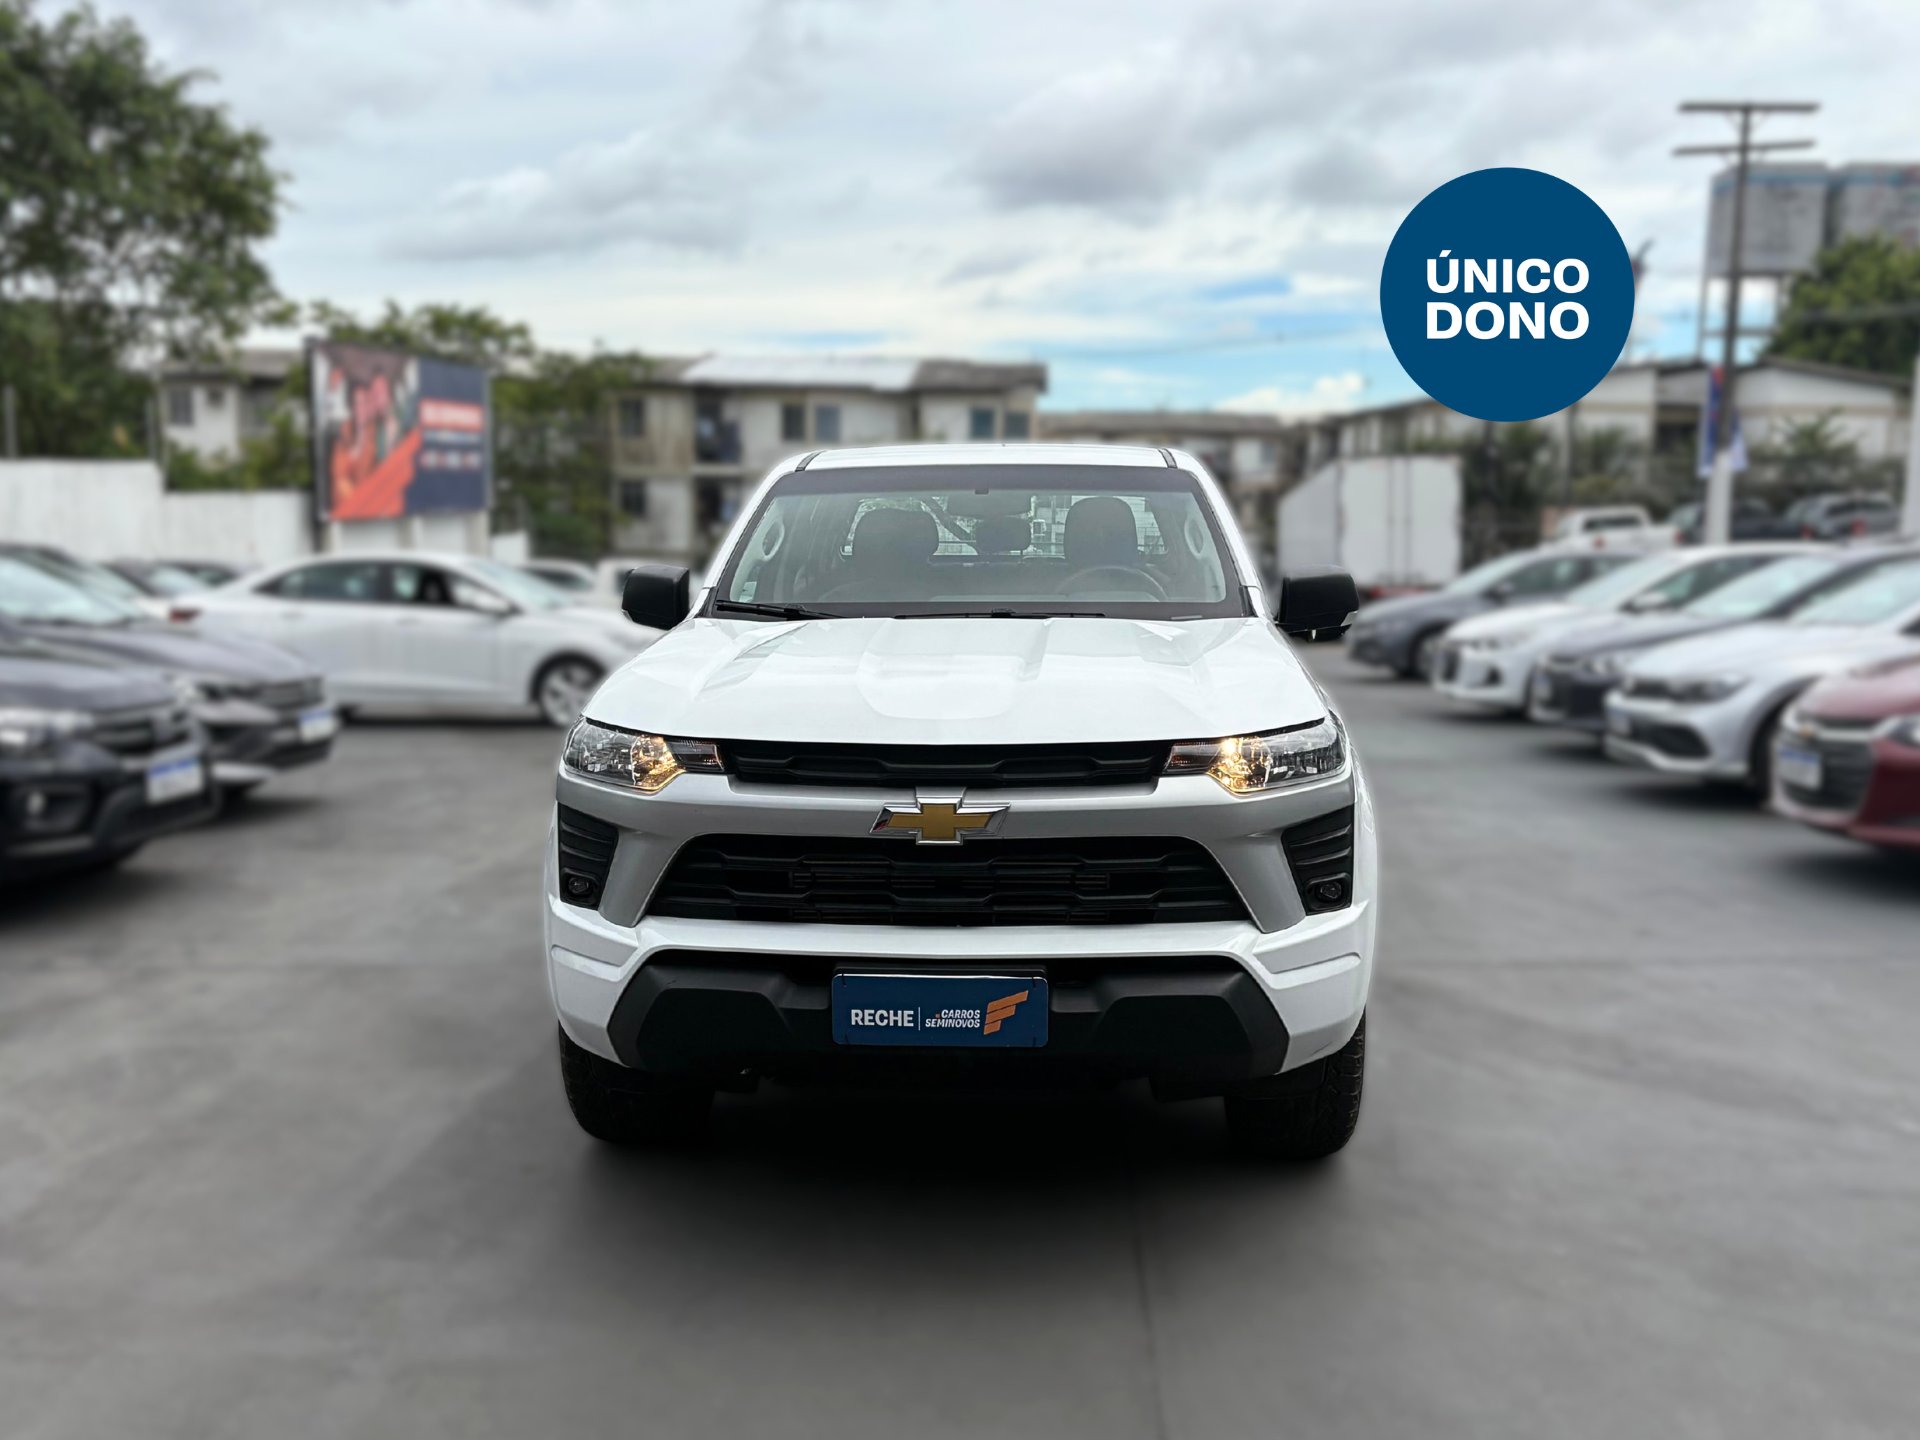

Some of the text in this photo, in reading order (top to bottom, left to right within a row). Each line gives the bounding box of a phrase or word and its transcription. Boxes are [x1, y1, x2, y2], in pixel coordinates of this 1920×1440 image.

[850, 1009, 914, 1027] RECHE
[941, 1009, 981, 1019] CARROS
[925, 1018, 981, 1028] SEMINOVOS
